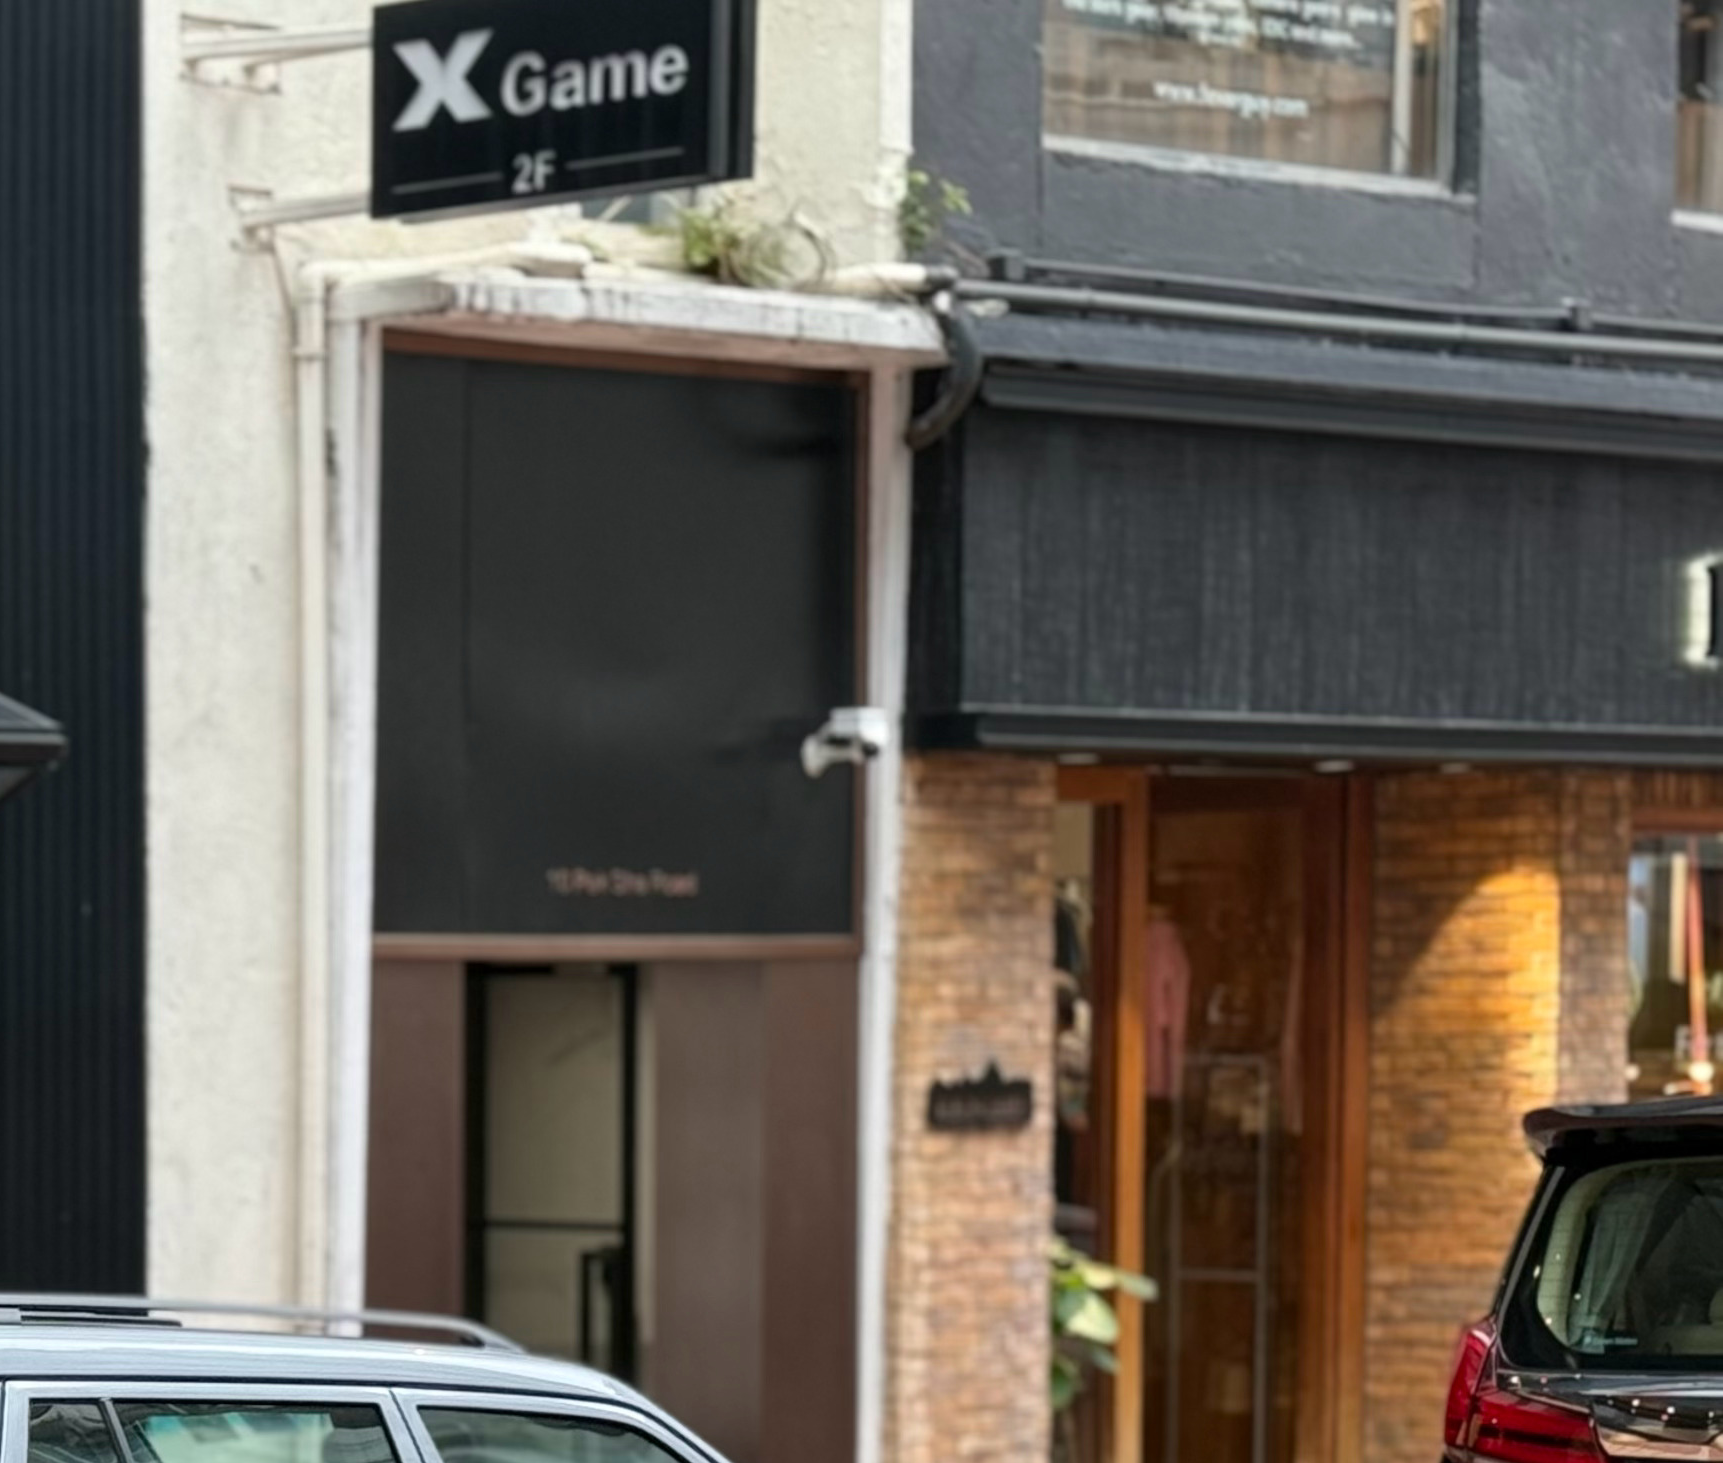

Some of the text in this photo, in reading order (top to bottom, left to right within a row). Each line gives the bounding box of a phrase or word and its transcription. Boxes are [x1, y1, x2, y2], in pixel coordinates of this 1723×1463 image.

[392, 28, 689, 132] X Game
[511, 150, 556, 194] 2F
